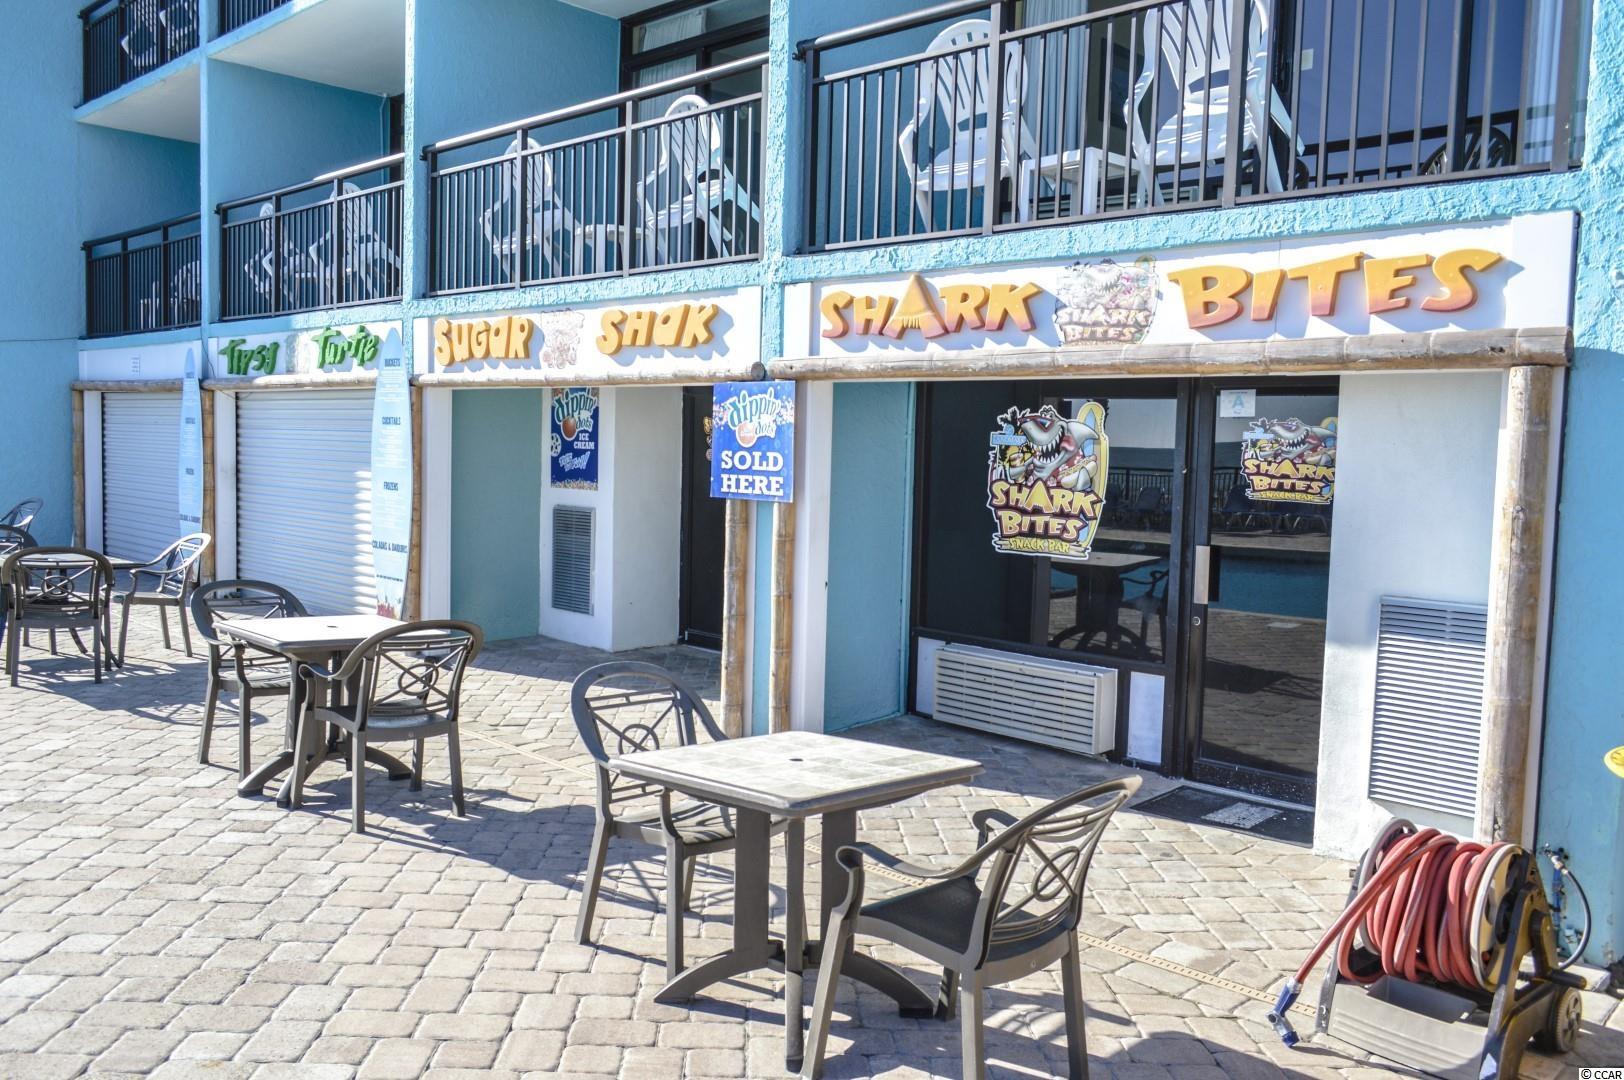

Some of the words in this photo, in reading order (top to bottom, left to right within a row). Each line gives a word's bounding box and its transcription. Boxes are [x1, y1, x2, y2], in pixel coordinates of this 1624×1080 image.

[819, 272, 1044, 339] SHARK
[1167, 248, 1504, 330] BITES
[1056, 303, 1152, 326] SHARK
[434, 315, 534, 367] SUGAR
[595, 304, 720, 355] SHAK
[1063, 325, 1138, 342] BITES
[1231, 394, 1245, 409] A
[573, 441, 595, 450] CREAM
[721, 450, 784, 472] SOLD
[1244, 458, 1335, 481] SHARK
[720, 473, 784, 496] HERE
[1249, 475, 1326, 494] BITES
[992, 480, 1099, 517] SHARK
[998, 509, 1083, 539] BITES
[1008, 537, 1045, 551] SNACK
[1048, 540, 1070, 553] BAR
